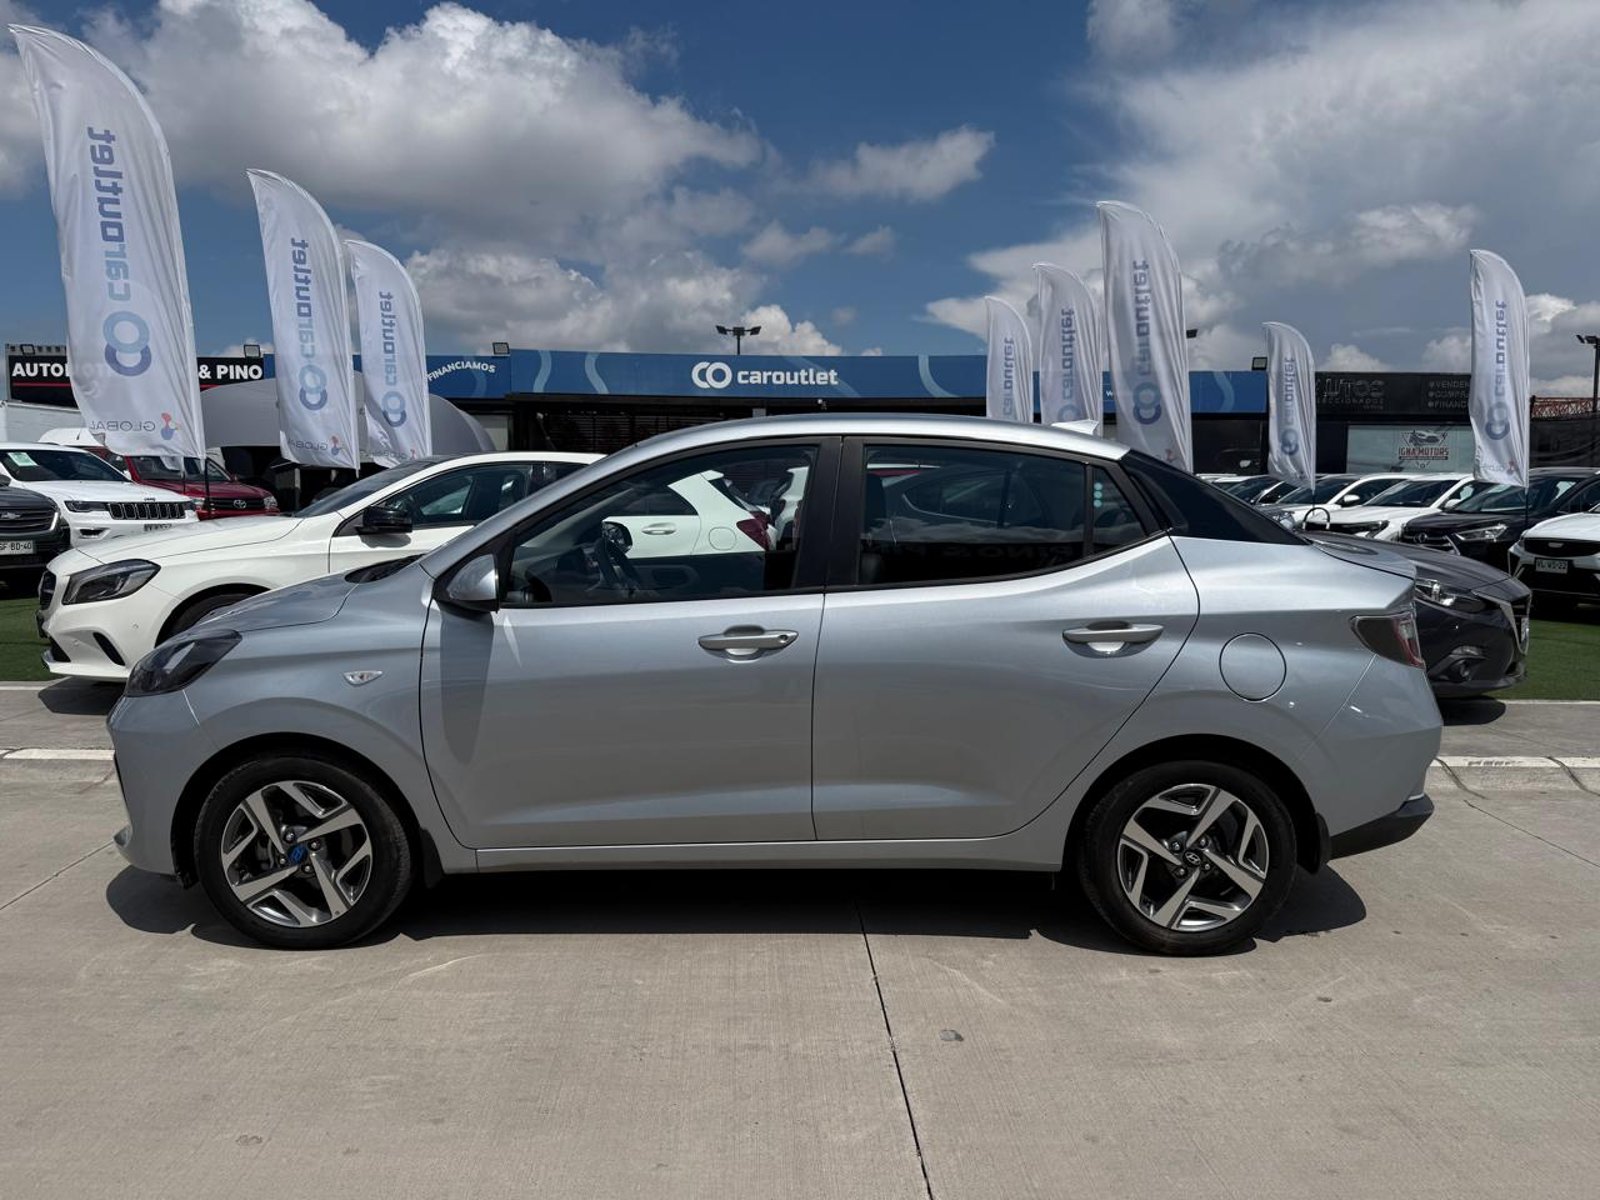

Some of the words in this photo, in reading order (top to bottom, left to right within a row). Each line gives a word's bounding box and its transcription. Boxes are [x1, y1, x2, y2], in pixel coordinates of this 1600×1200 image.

[199, 364, 211, 379] &
[217, 364, 263, 380] PINO
[426, 361, 496, 381] FINANCIAMOS
[737, 368, 838, 385] caroutlet
